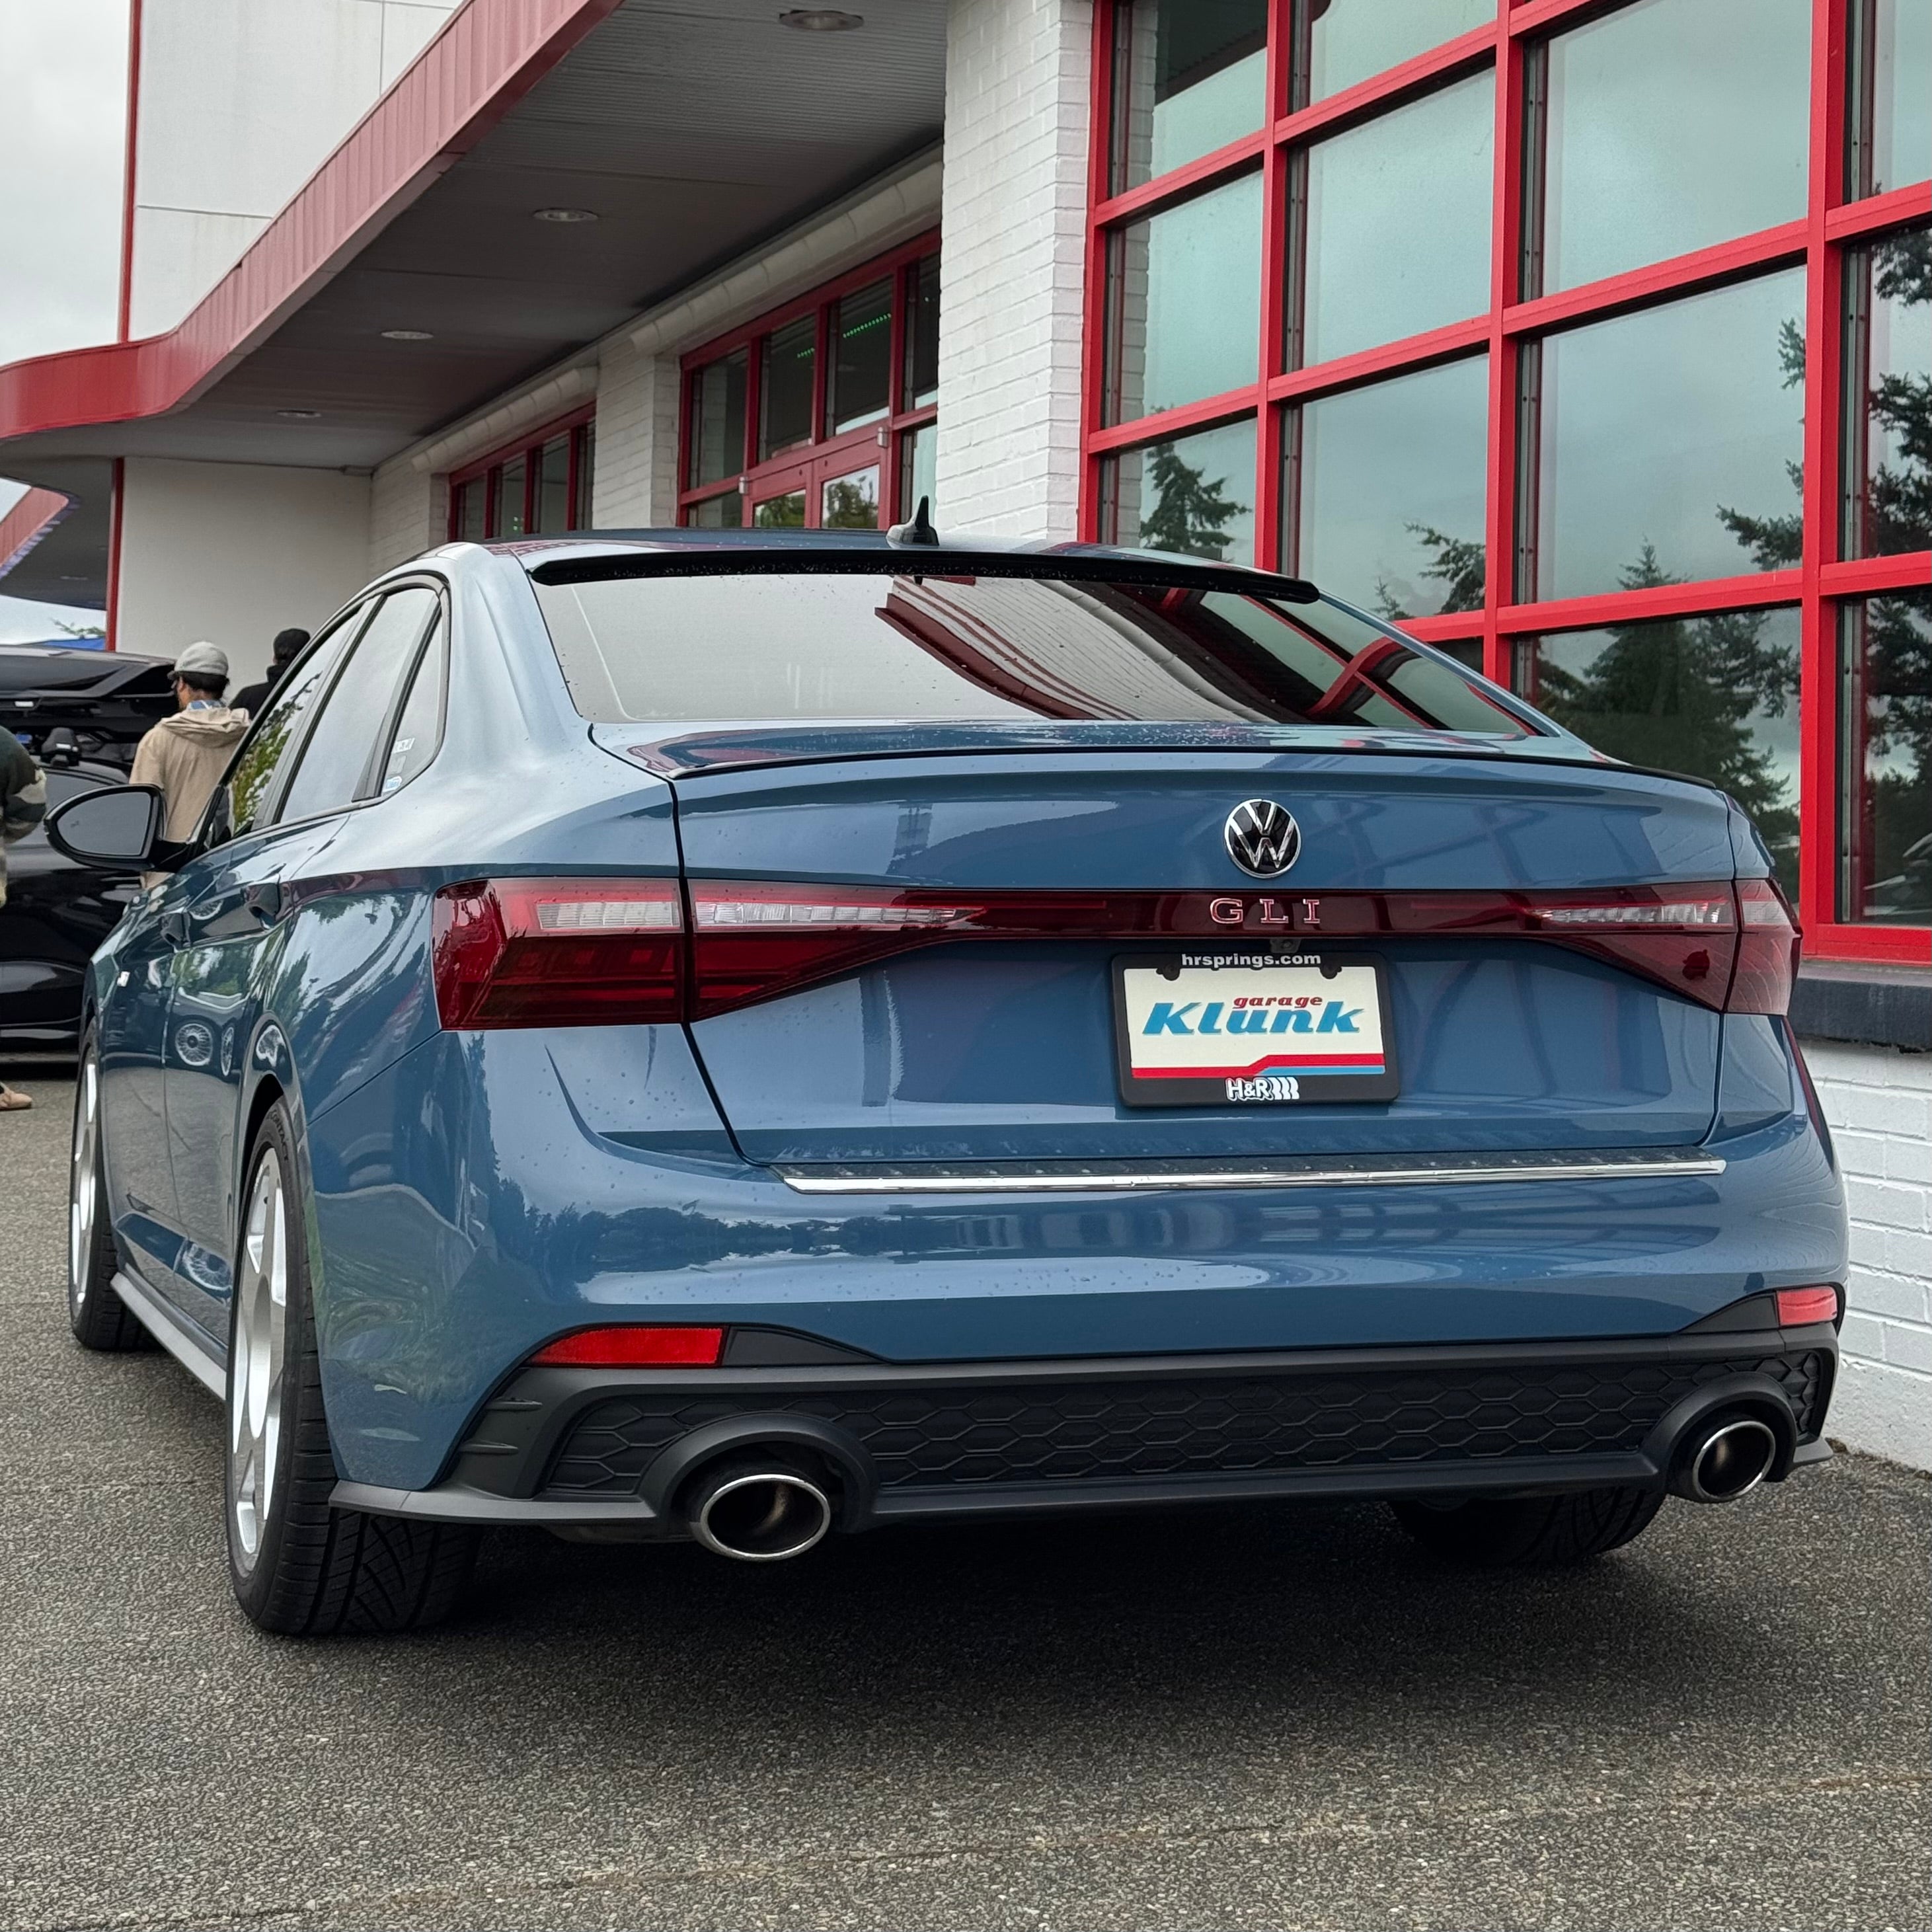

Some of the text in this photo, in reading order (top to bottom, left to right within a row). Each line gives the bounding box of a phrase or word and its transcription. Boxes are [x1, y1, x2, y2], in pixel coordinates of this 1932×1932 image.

[1226, 799, 1299, 876] VW
[1210, 898, 1321, 924] GLI
[1182, 954, 1321, 968] hrsprings.com
[1233, 996, 1323, 1009] garage
[1142, 1001, 1365, 1035] Klunk
[1225, 1077, 1275, 1101] H&R
